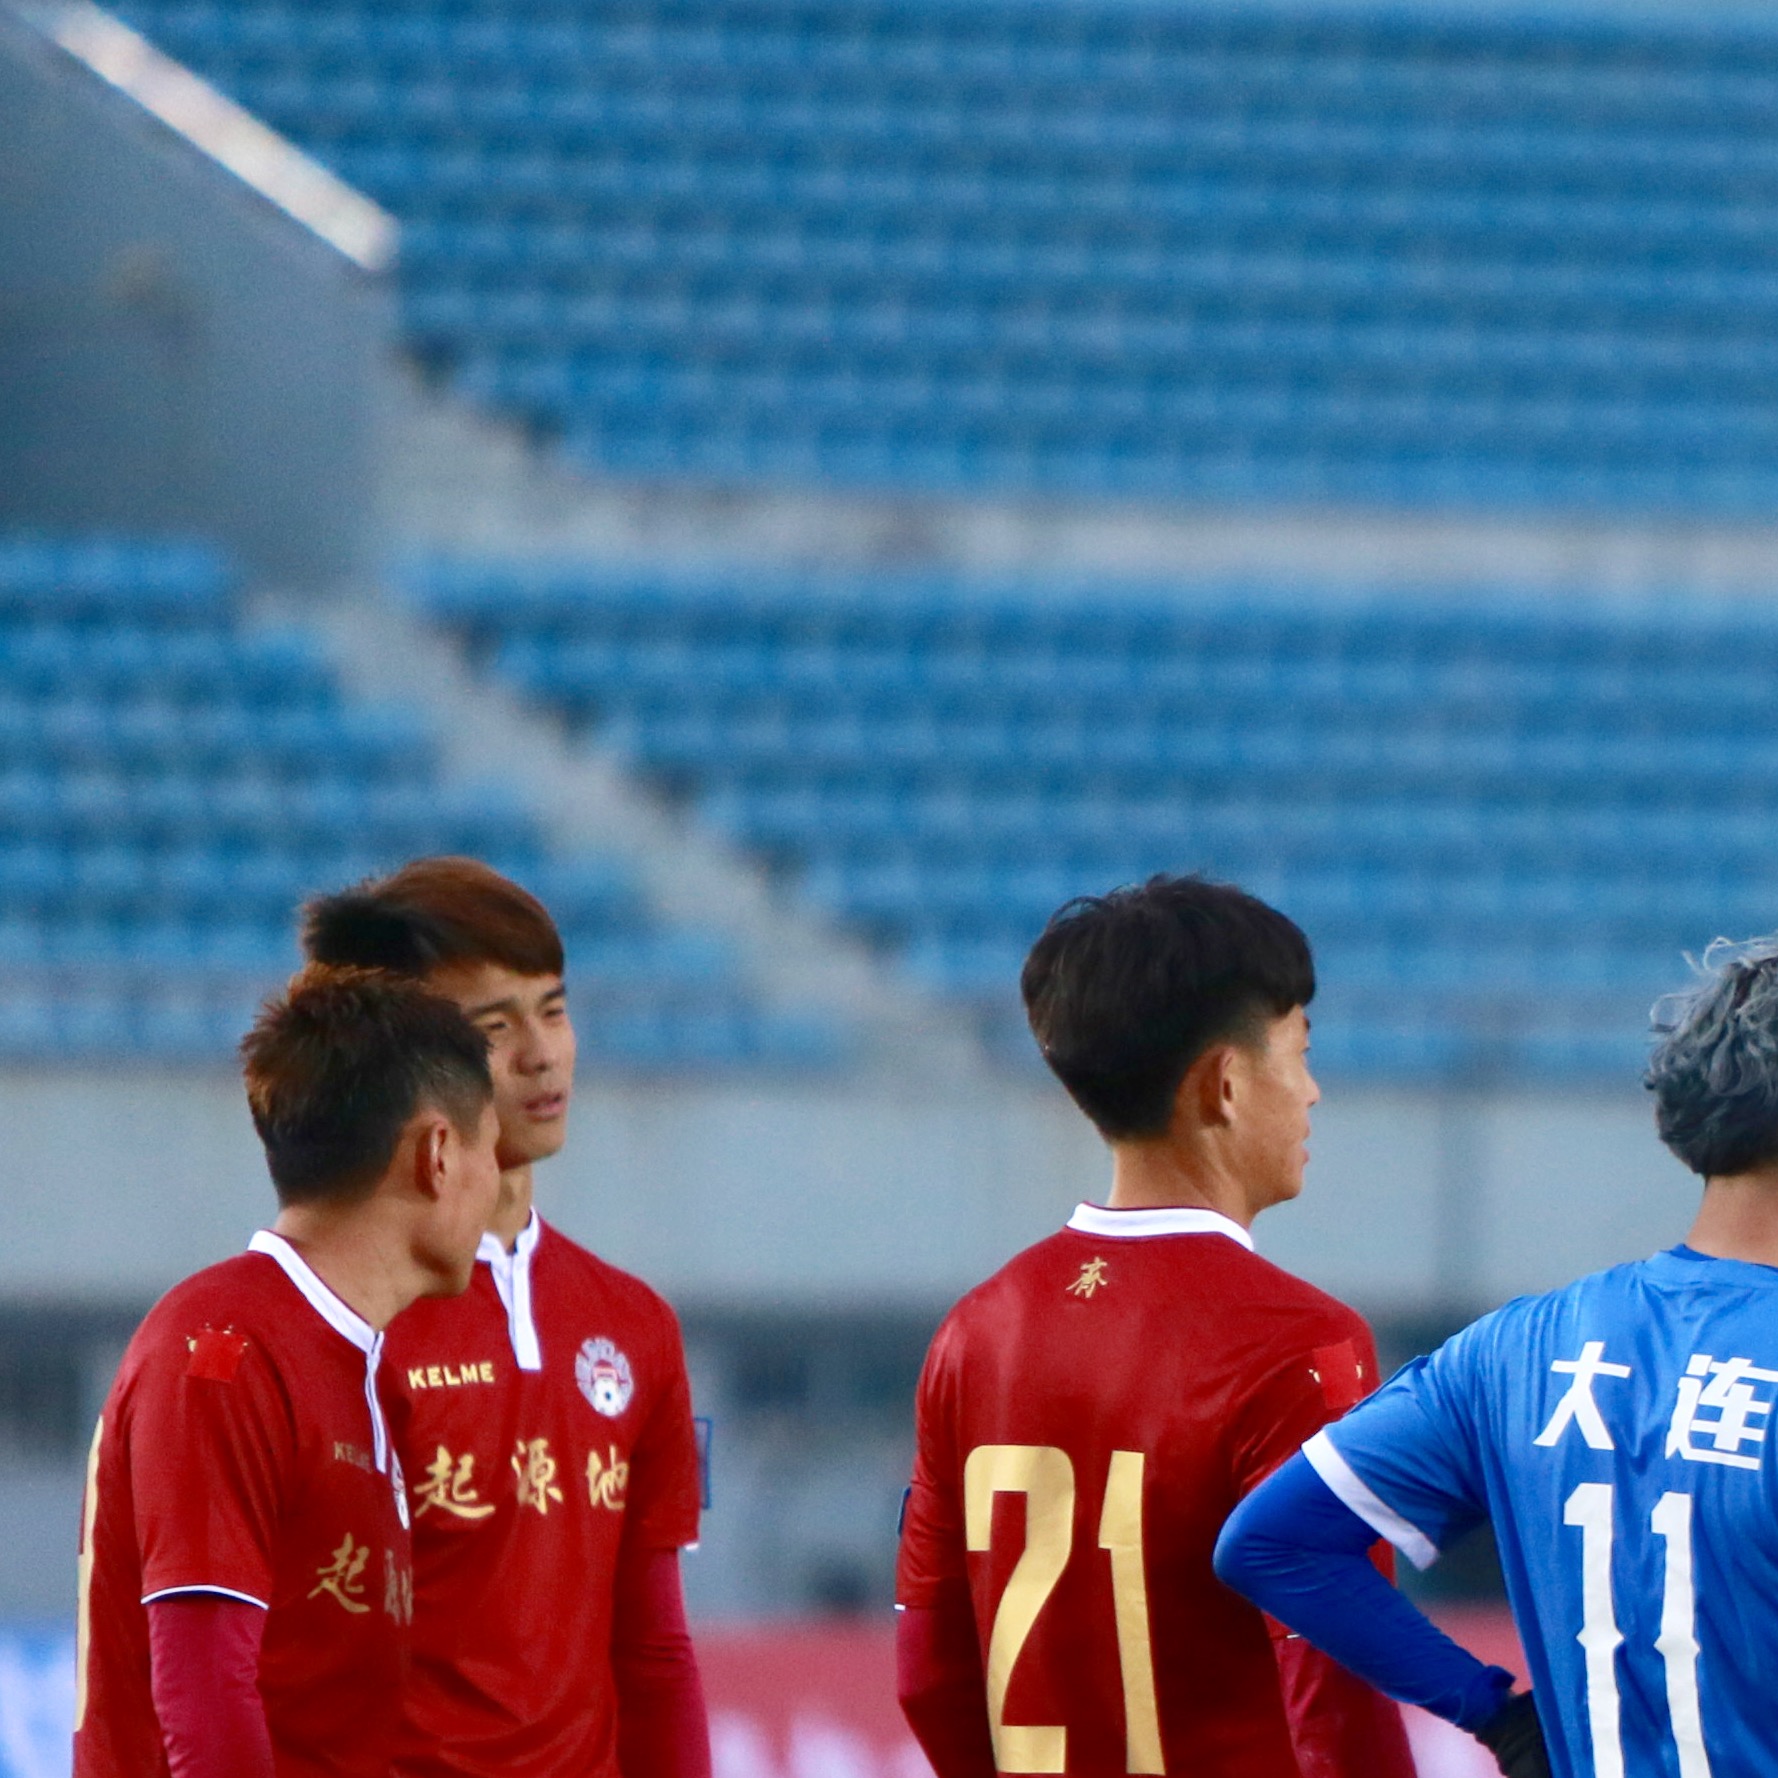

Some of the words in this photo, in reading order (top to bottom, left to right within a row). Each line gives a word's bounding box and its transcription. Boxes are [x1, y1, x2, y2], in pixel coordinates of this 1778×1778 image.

[408, 1362, 494, 1389] KELME
[413, 1437, 628, 1519] 起源地
[963, 1444, 1166, 1776] 21
